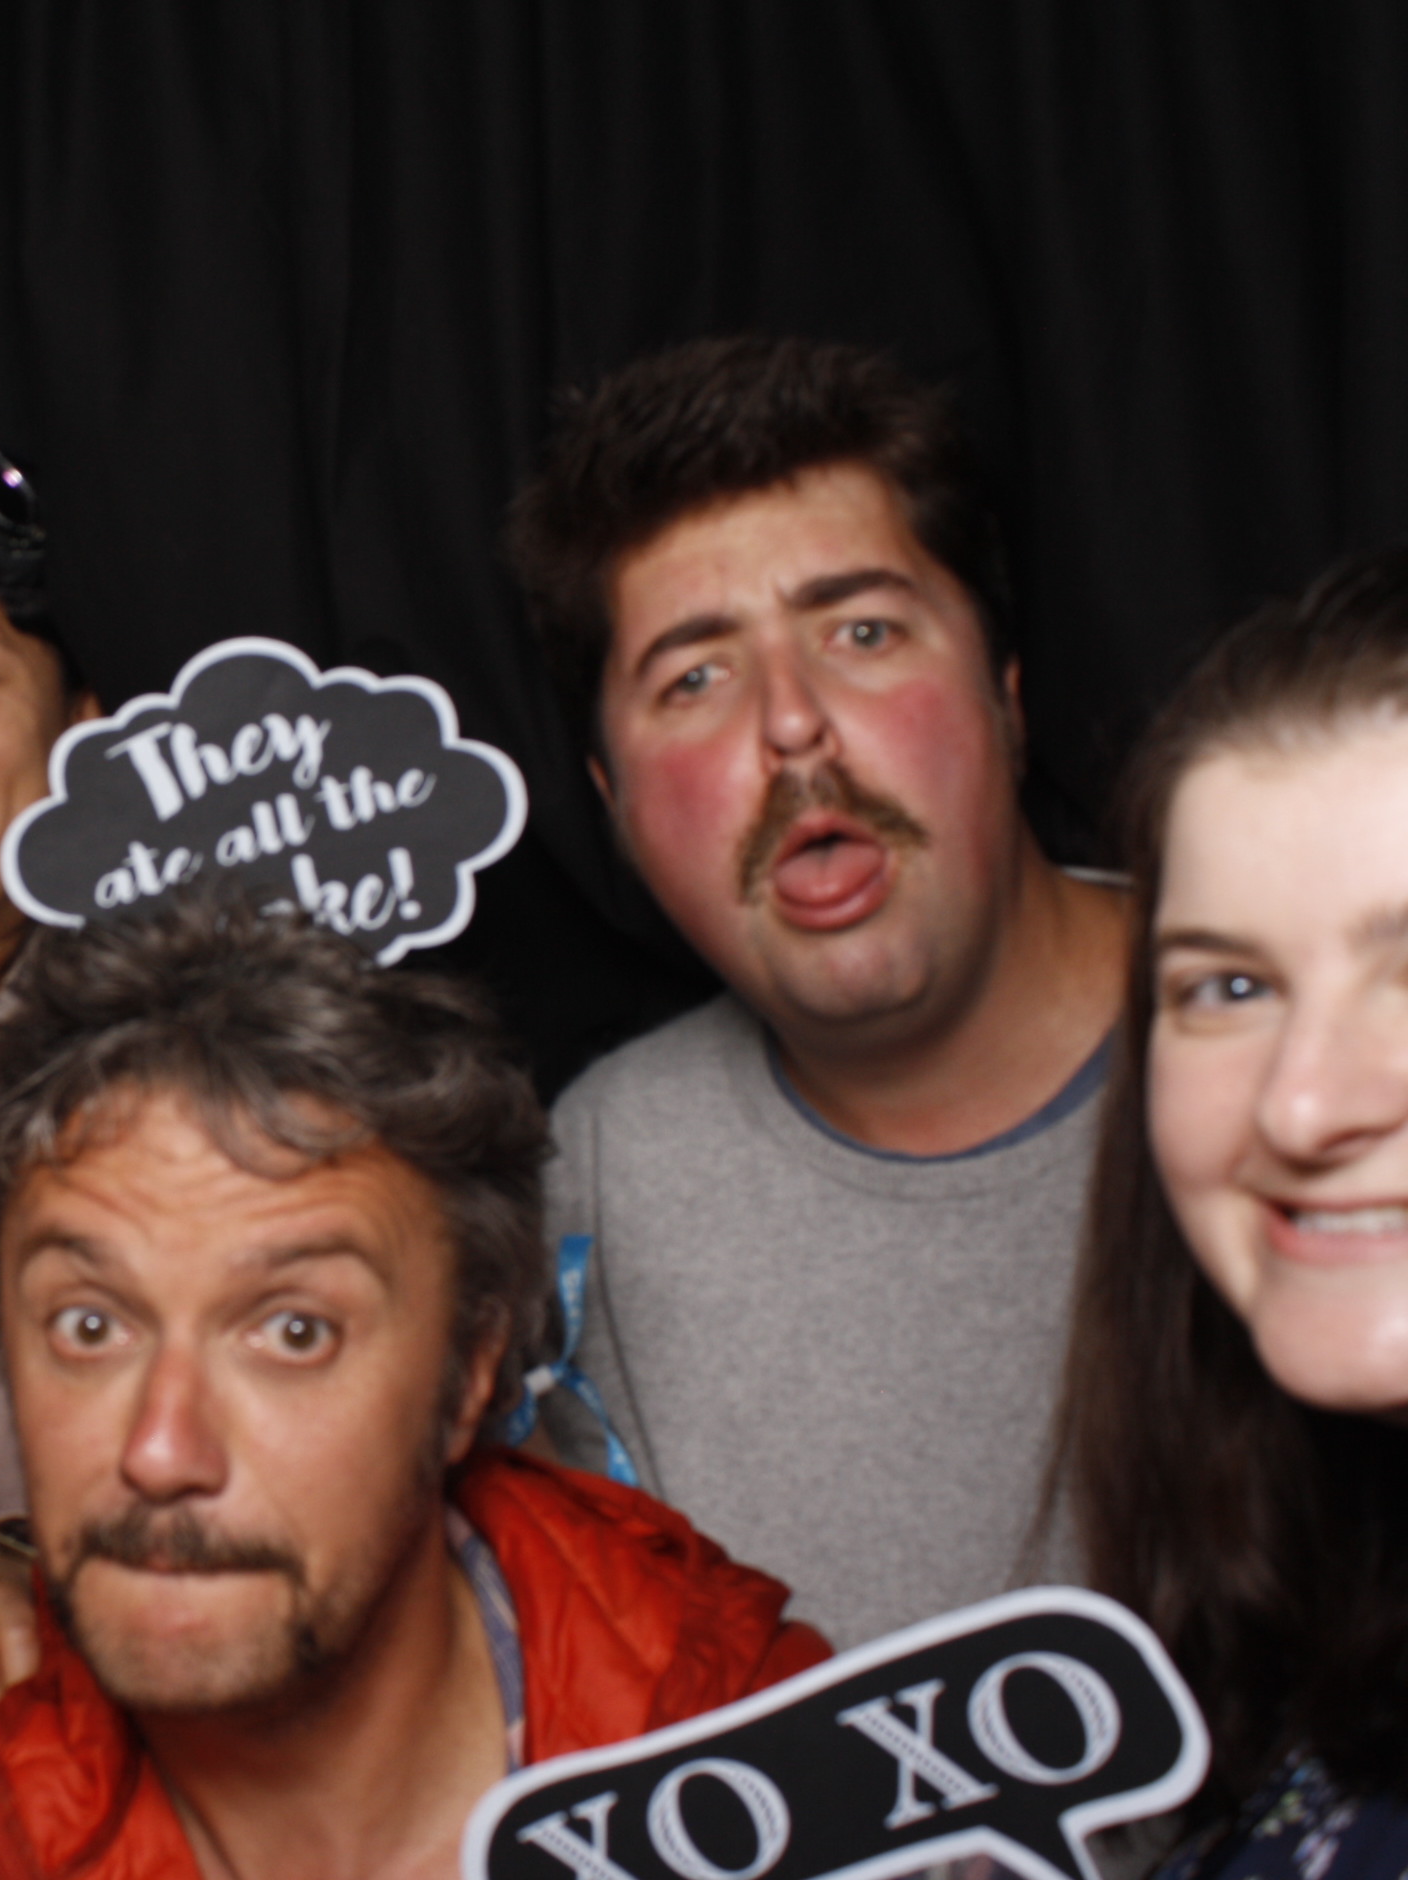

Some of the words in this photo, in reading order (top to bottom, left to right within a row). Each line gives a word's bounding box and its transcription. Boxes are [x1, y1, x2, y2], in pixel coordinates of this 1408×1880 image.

[105, 712, 331, 821] They
[94, 841, 203, 907] ate
[217, 793, 315, 867] all
[314, 765, 437, 830] the
[260, 846, 421, 936] ke!
[516, 1757, 791, 1880] XO
[837, 1650, 1122, 1829] XO
